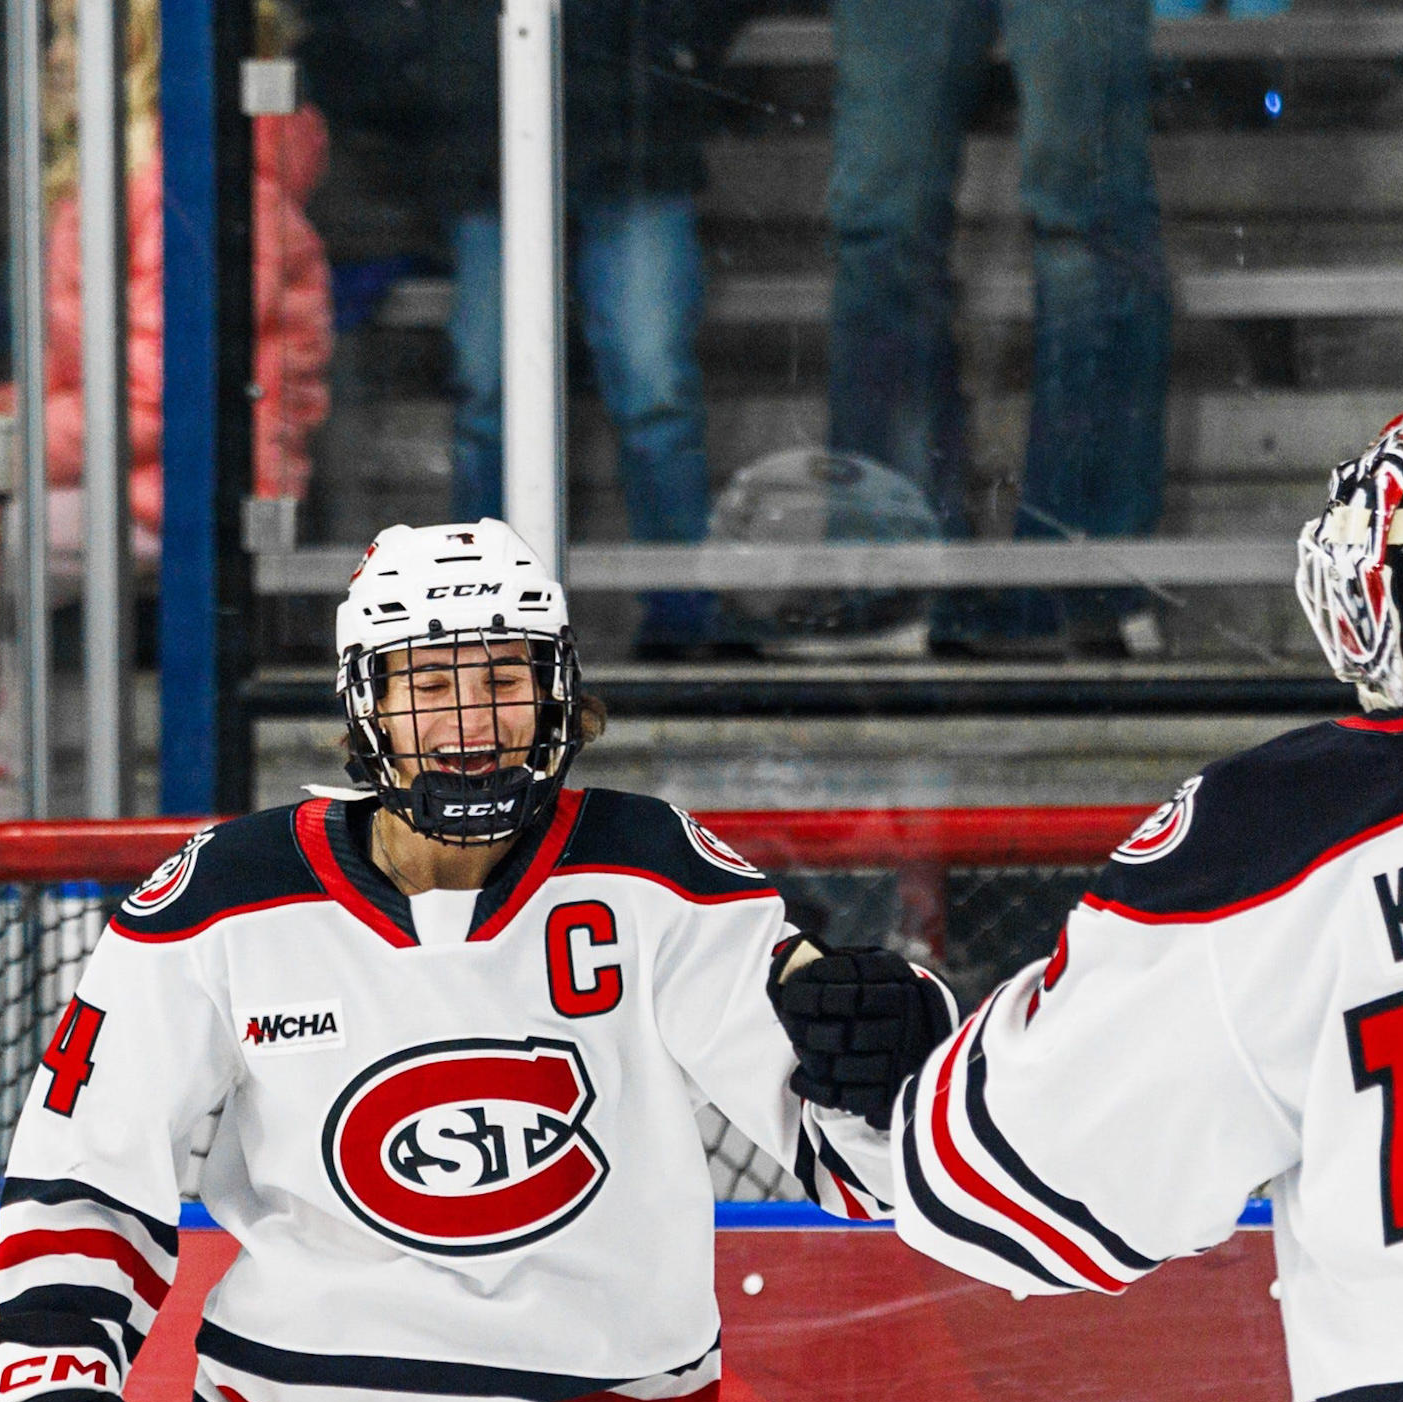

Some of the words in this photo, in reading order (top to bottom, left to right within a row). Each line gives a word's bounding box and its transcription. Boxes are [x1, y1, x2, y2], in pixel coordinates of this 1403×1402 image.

[426, 582, 502, 600] CCM
[442, 800, 515, 817] CCM
[545, 900, 623, 1019] C
[242, 1011, 338, 1045] WCHA
[42, 992, 107, 1118] 4
